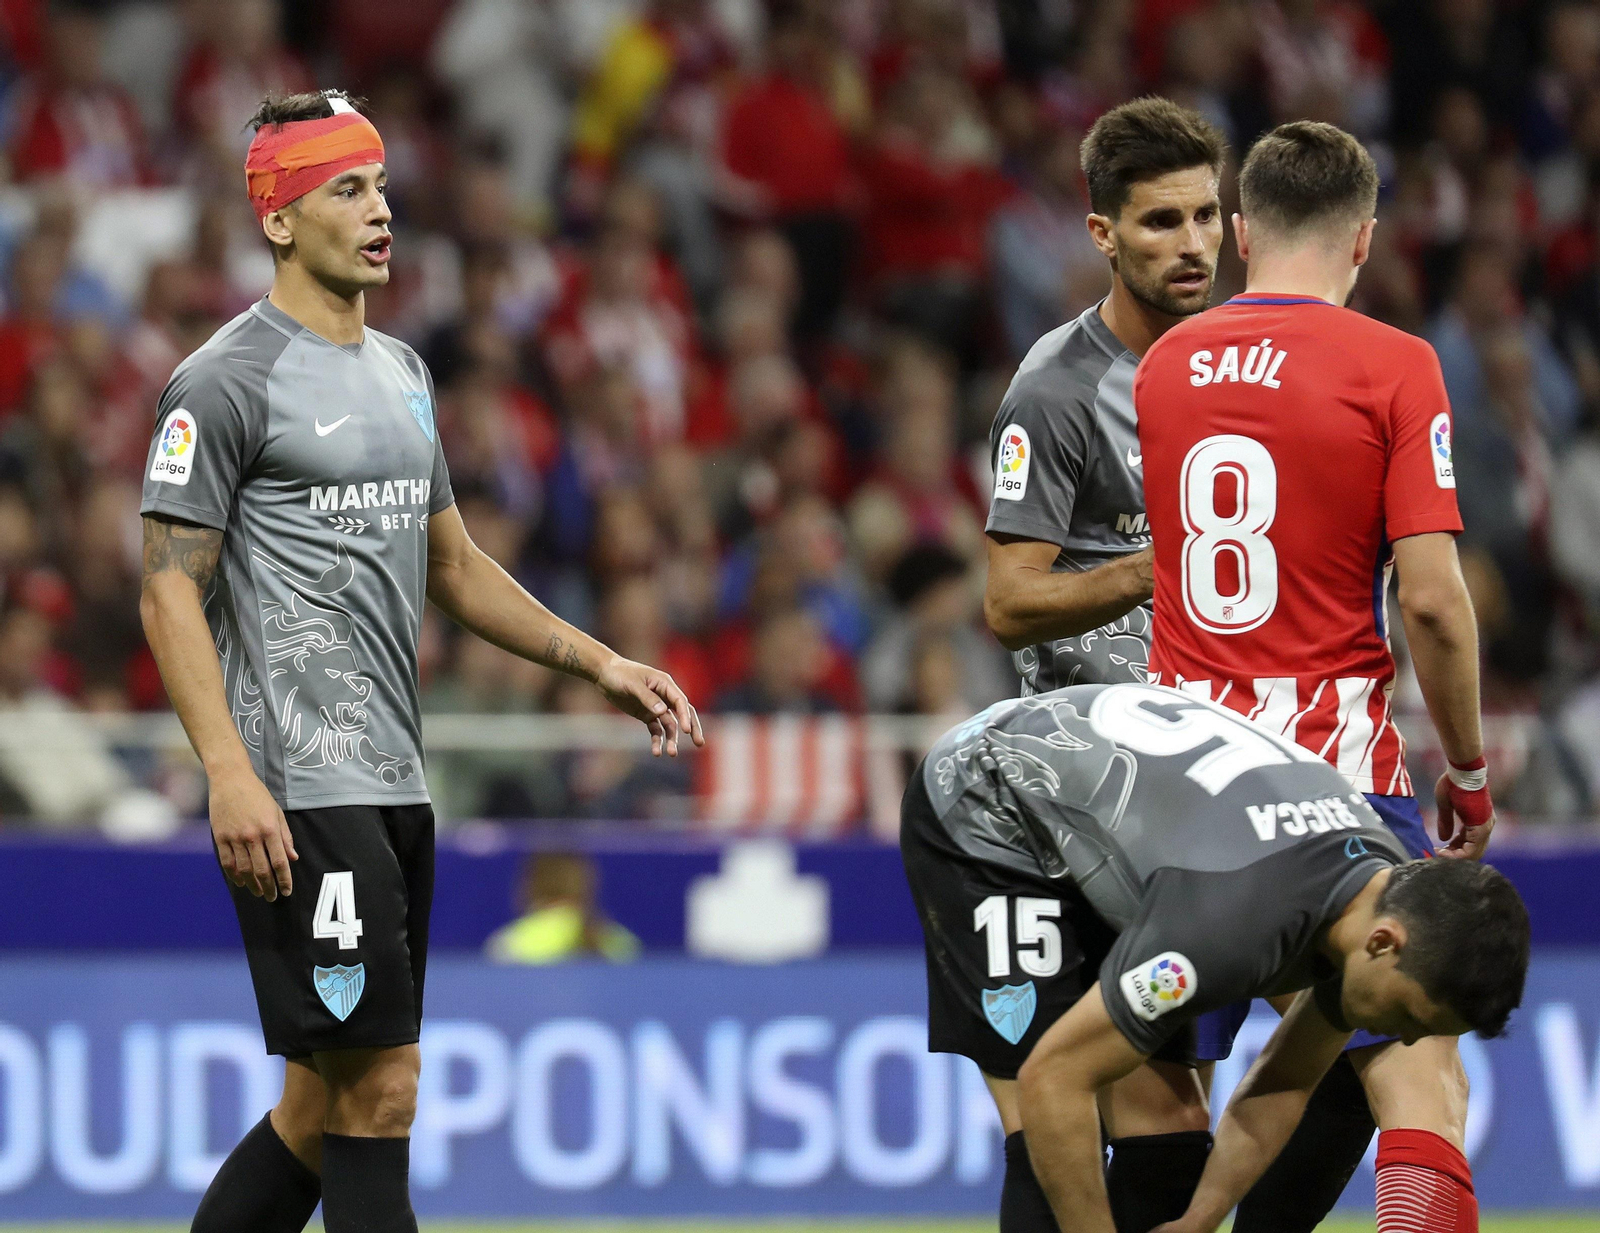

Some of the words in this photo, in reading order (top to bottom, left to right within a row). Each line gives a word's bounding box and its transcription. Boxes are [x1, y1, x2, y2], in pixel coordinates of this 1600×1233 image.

[1188, 338, 1288, 390] SAÚL
[380, 513, 412, 531] BET
[1179, 434, 1279, 635] 8
[1245, 795, 1362, 842] RICCA
[312, 870, 363, 950] 4
[973, 895, 1063, 978] 15
[1131, 973, 1157, 1014] LaLiga
